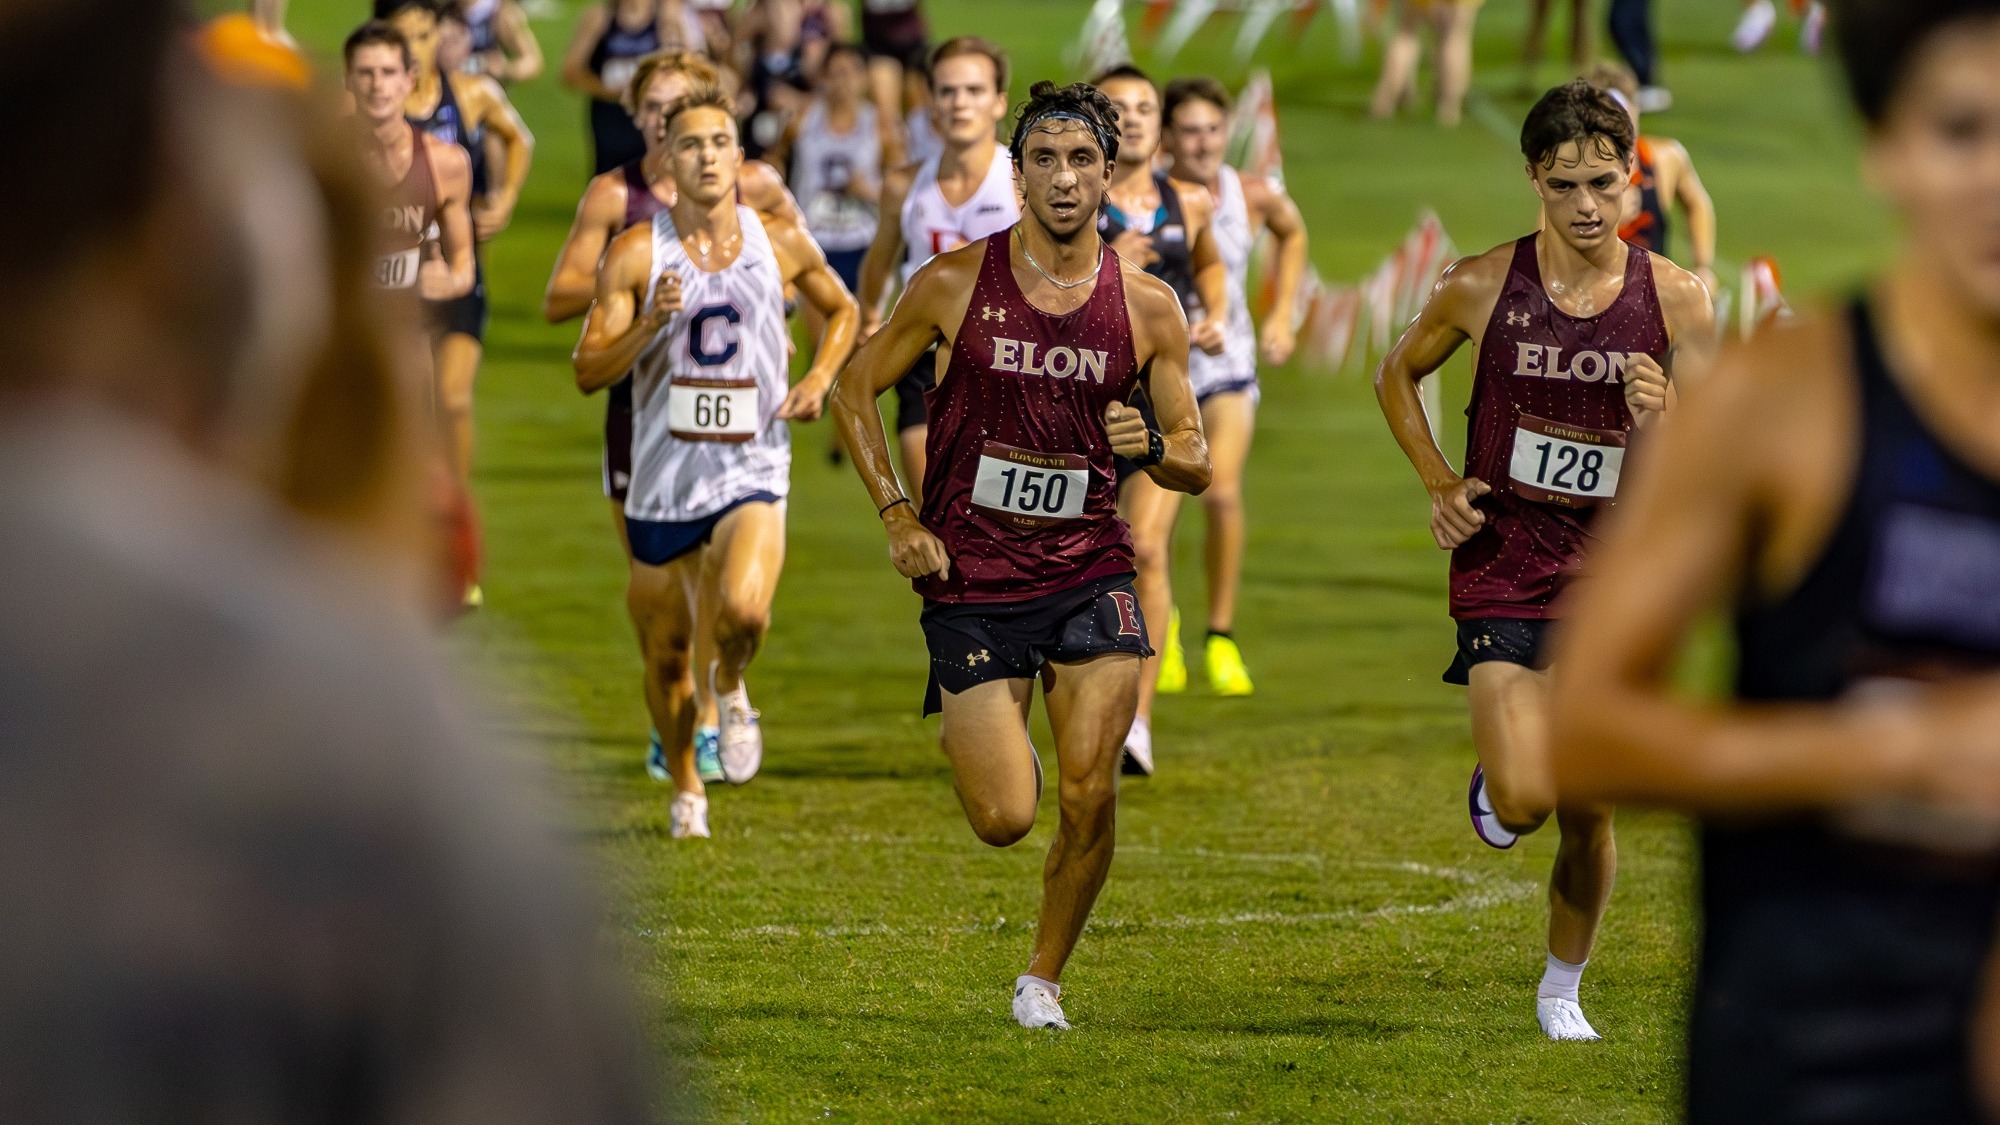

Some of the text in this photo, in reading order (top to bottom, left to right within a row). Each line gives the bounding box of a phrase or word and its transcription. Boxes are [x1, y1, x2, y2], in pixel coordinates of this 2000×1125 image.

[688, 302, 743, 367] C
[989, 336, 1109, 384] ELON
[1512, 341, 1635, 384] ELON
[696, 394, 731, 428] 66
[1536, 441, 1604, 492] 128
[1001, 467, 1069, 514] 150
[1107, 591, 1142, 637] E
